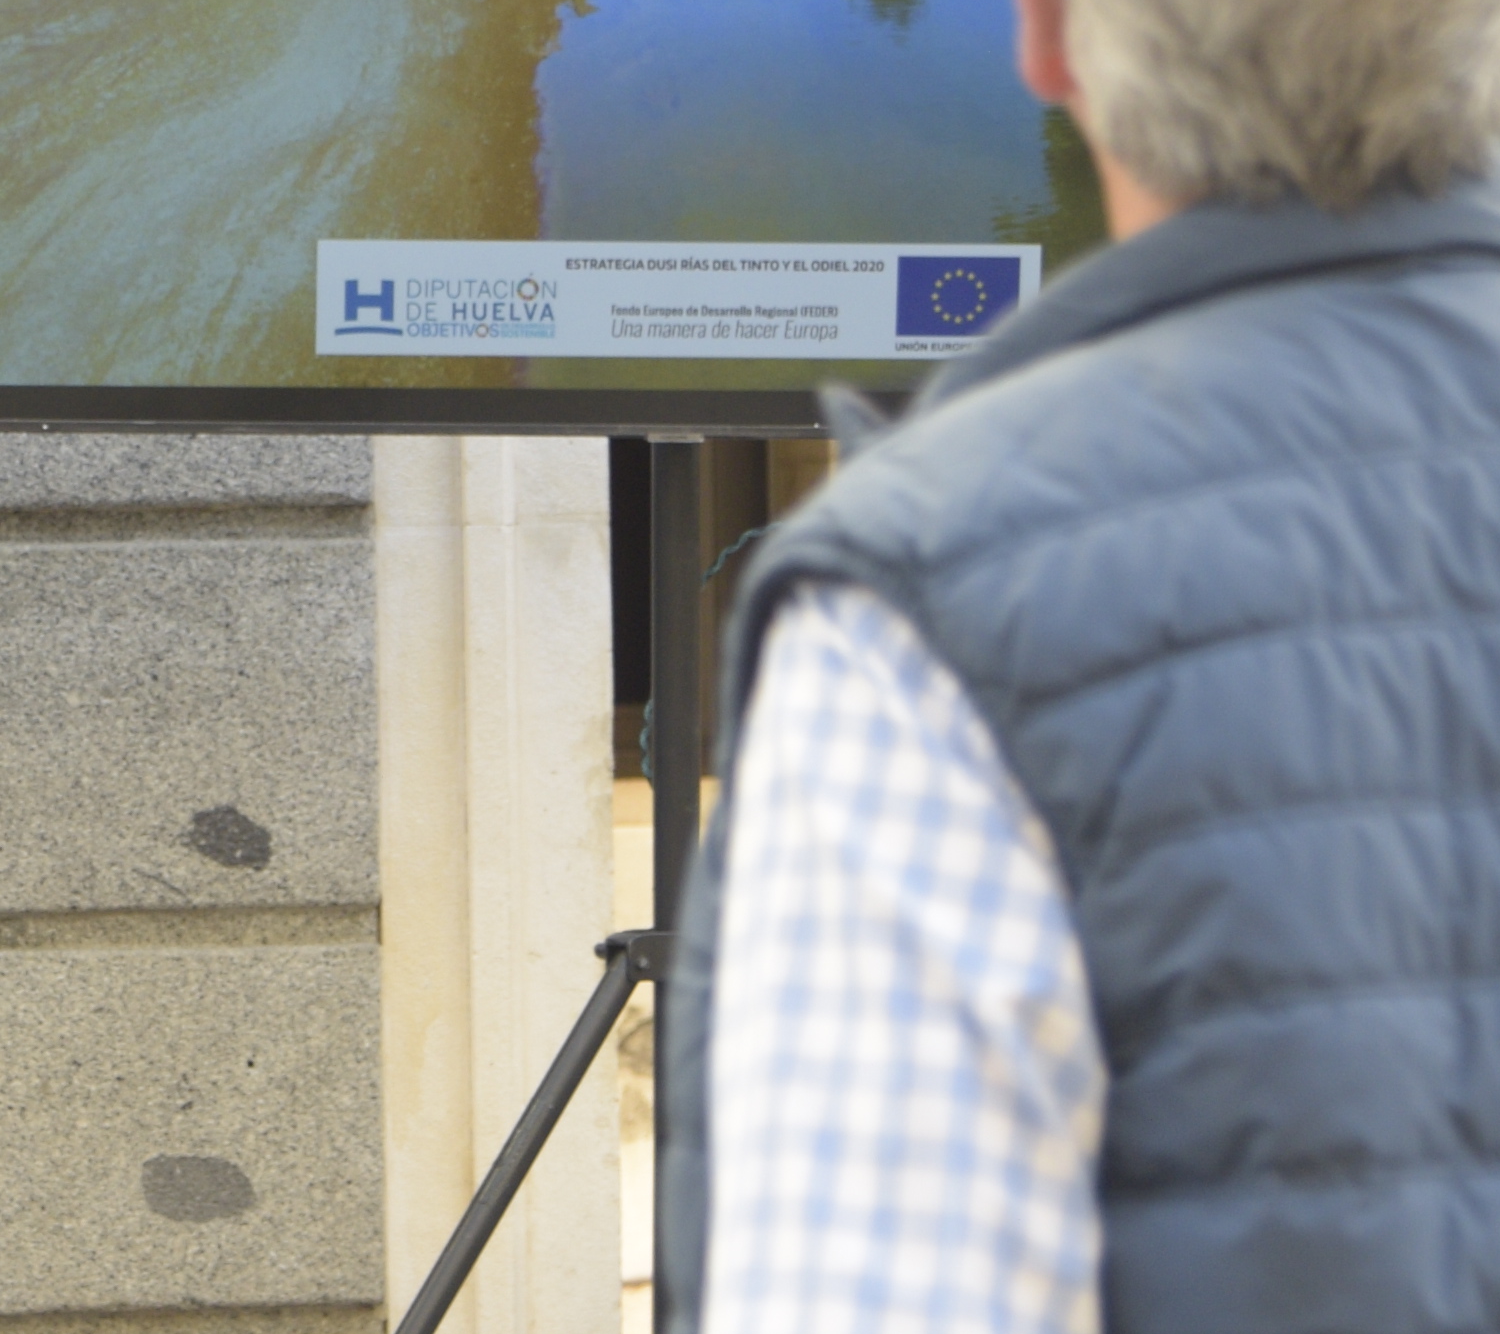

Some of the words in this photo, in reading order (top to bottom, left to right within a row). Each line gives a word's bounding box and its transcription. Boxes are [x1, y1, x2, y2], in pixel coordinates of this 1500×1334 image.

[565, 257, 645, 271] ESTRATEGIA
[646, 258, 678, 272] DUSI
[680, 256, 710, 272] RÍAS
[712, 258, 738, 272] DEL
[739, 259, 780, 272] TINTO
[781, 259, 791, 272] Y
[792, 259, 809, 272] EL
[810, 259, 850, 273] ODIEL
[852, 260, 885, 273] 2020
[406, 273, 557, 300] DIPUTACIÓN
[344, 279, 395, 322] H
[406, 303, 437, 322] DE
[451, 303, 555, 322] HUELVA
[611, 304, 641, 317] Fondo
[643, 304, 684, 319] Europeo
[686, 305, 699, 317] de
[701, 304, 753, 317] Desarrollo
[755, 305, 798, 320] Regional
[800, 305, 839, 318] (FEDER)
[406, 322, 500, 338] OBJETIVOS
[611, 319, 644, 339] Una
[647, 323, 707, 339] manera
[711, 319, 731, 339] de
[735, 320, 780, 340] hacer
[784, 319, 840, 343] Europa
